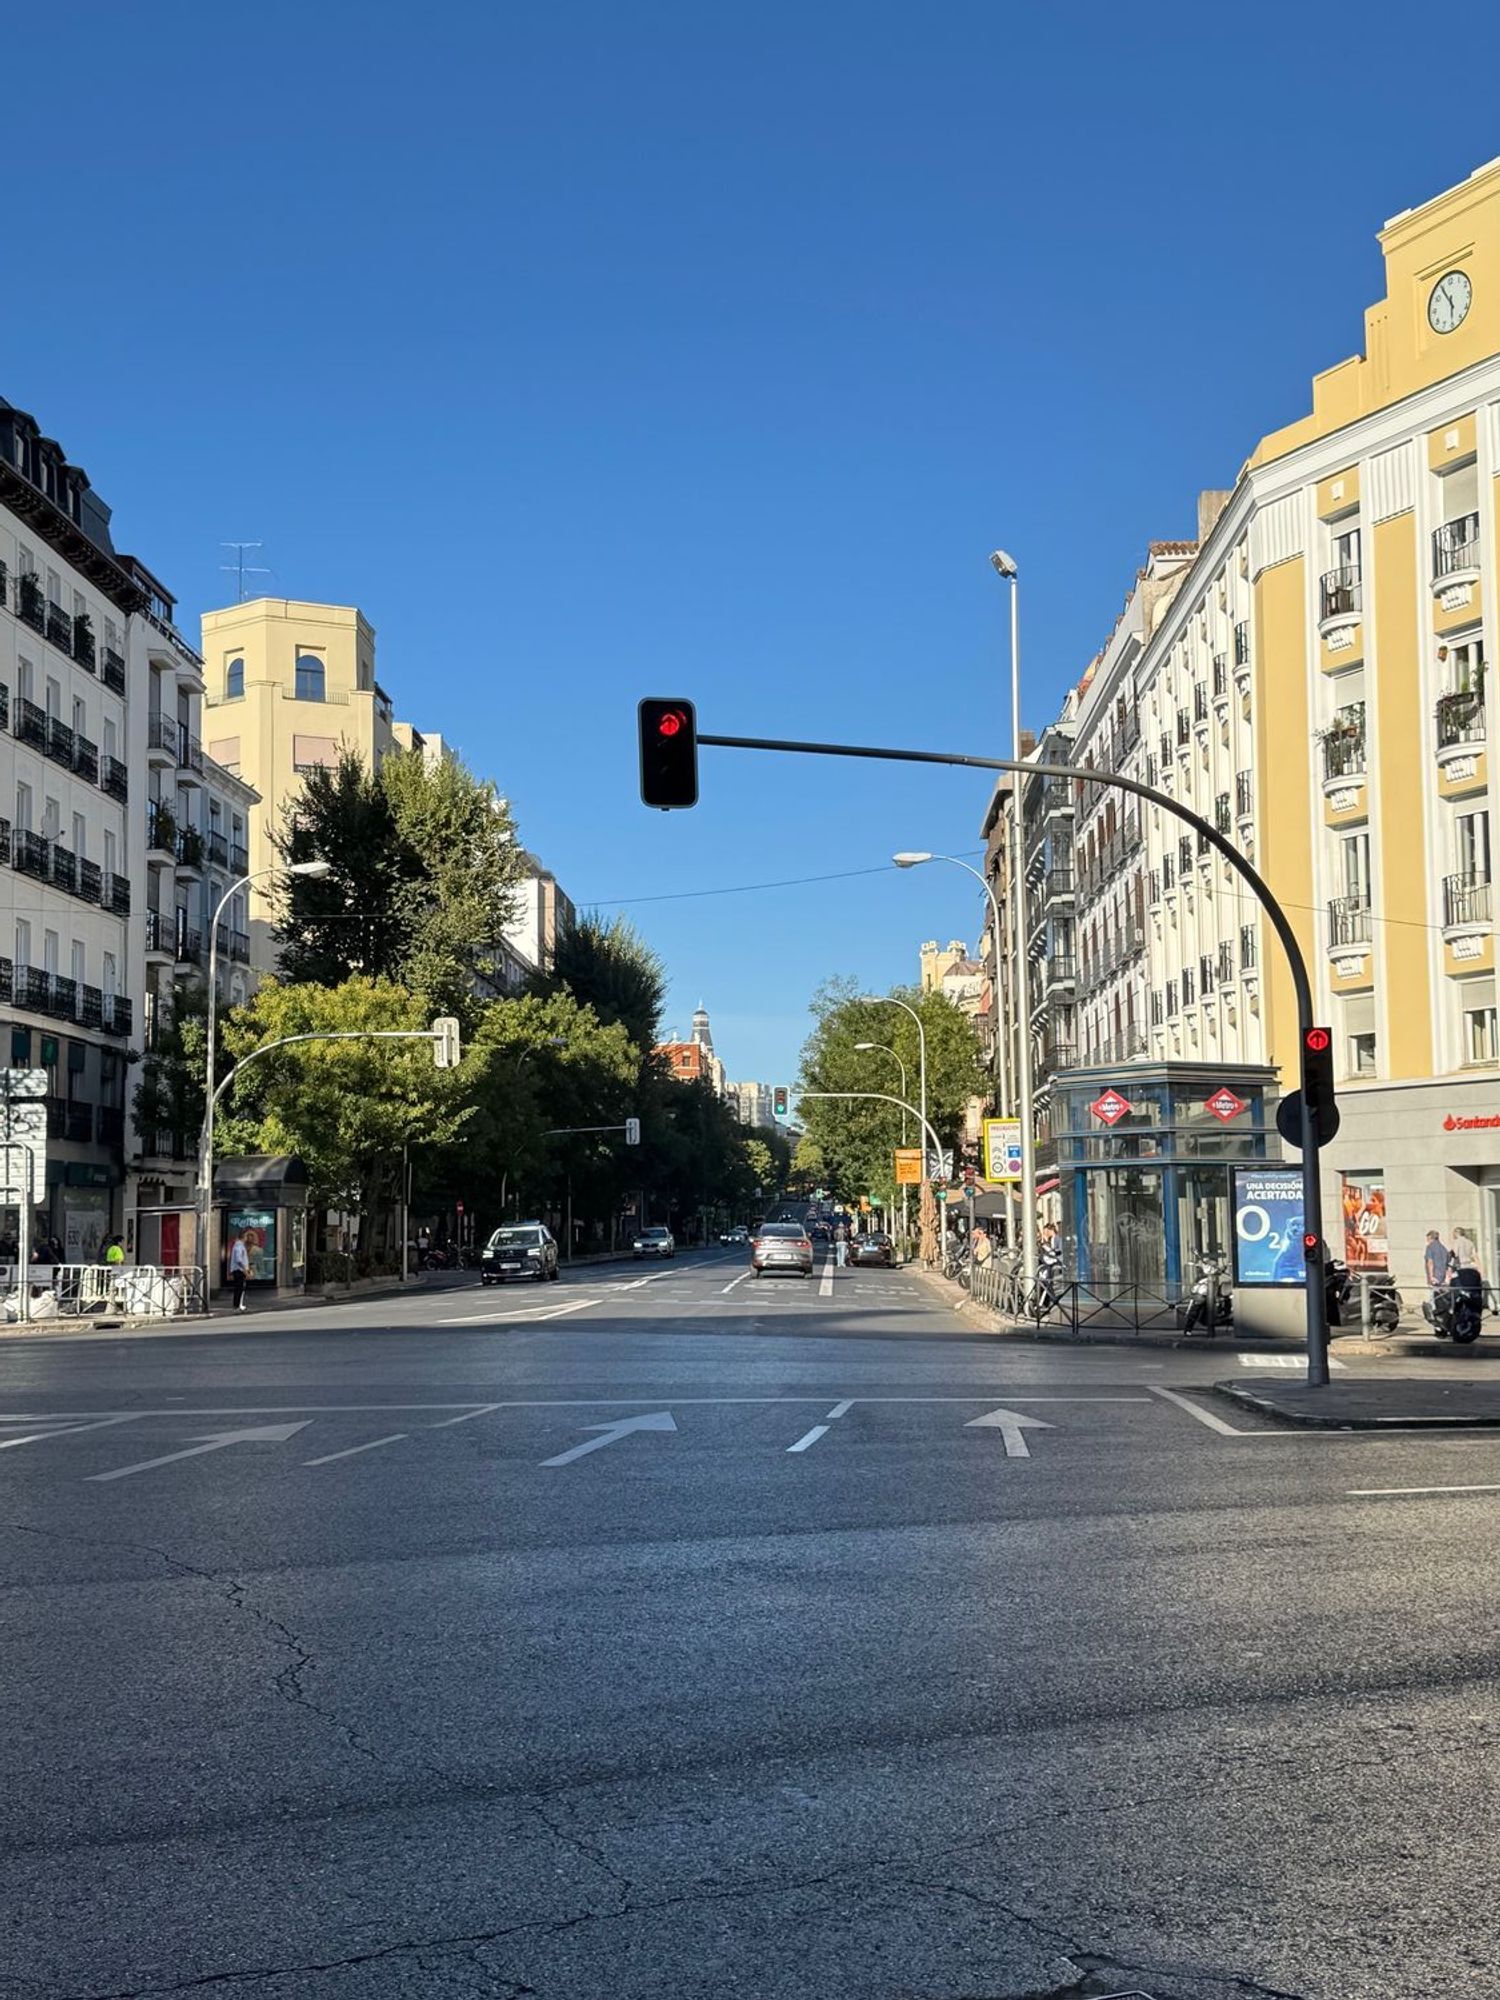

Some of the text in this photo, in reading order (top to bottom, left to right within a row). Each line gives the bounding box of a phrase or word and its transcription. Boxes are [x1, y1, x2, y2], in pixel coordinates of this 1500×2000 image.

[1101, 1103, 1120, 1111] Metro
[1215, 1101, 1235, 1110] Metro
[1246, 1180, 1304, 1190] UNA DECISIÓN
[1246, 1190, 1304, 1200] ACERTADA
[1359, 1211, 1379, 1234] GO
